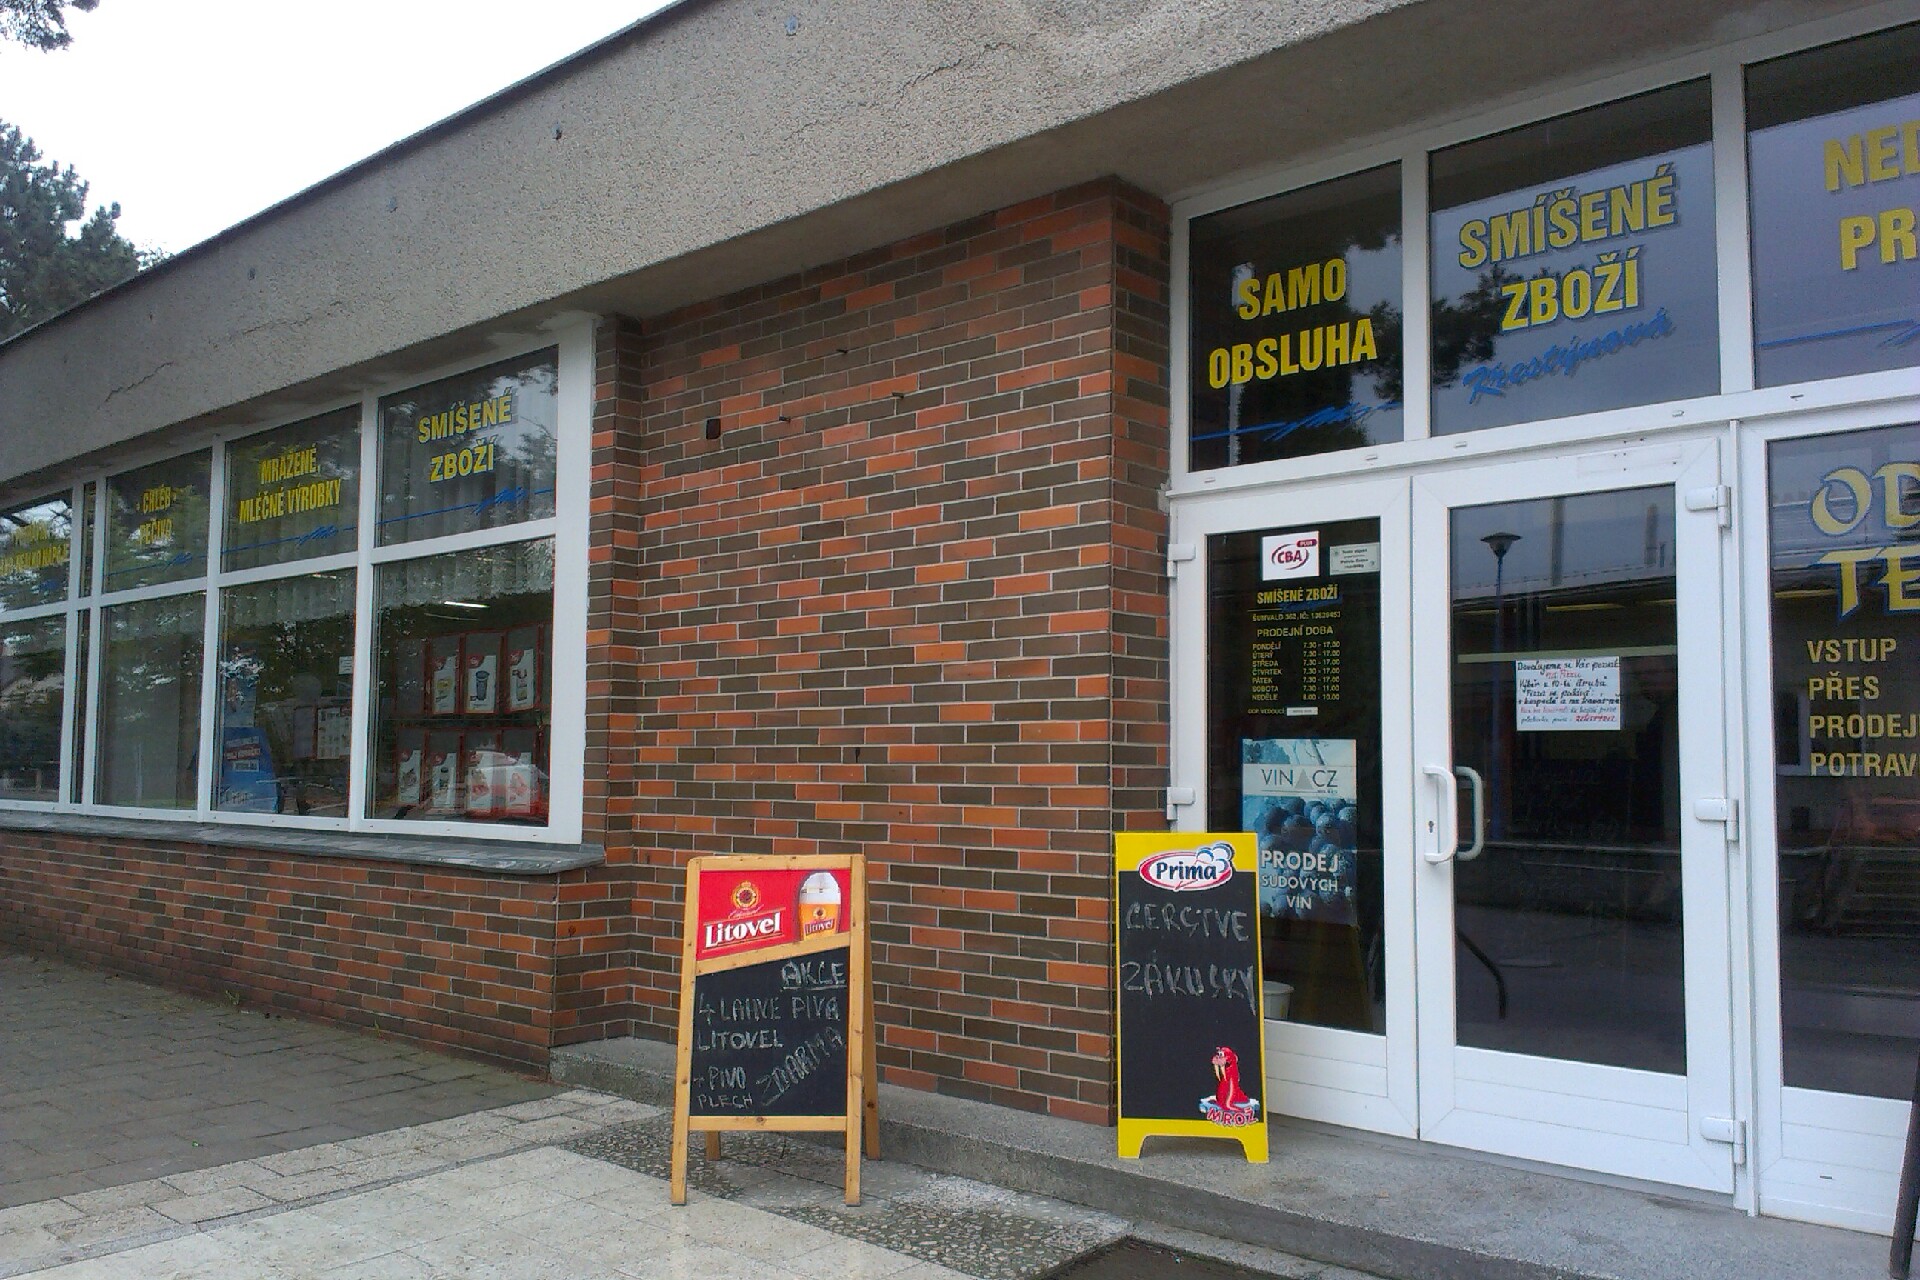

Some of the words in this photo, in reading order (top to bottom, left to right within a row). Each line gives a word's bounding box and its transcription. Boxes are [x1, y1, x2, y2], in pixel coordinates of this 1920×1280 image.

[1458, 162, 1677, 268] SMÍŠENÉ
[1238, 259, 1347, 320] SAMO
[1501, 246, 1643, 331] ZBOŽÍ
[1209, 319, 1378, 389] OBSLUHA
[418, 387, 514, 443] SMÍŠENÉ
[429, 434, 498, 482] ZBOŽÍ
[287, 478, 342, 513] VÝROBKY
[1277, 550, 1302, 564] CBA
[1257, 587, 1304, 604] SMÍŠENÉ
[1306, 584, 1338, 601] ZBOŽÍ
[1257, 624, 1304, 637] PRODEJNÍ
[1305, 626, 1334, 636] DOBA
[1807, 638, 1897, 663] VSTUP
[1252, 667, 1283, 676] ČTVRTEK
[1252, 676, 1273, 684] PÁTEK
[1252, 685, 1279, 693] SOBOTA
[1808, 671, 1880, 700] PŘES
[1809, 713, 1920, 739] PRODEJ
[1810, 752, 1920, 777] POTRAV
[1156, 861, 1217, 880] Prima
[1261, 850, 1339, 873] PRODEJ
[705, 912, 781, 948] Litovel
[805, 919, 834, 935] Litovel
[792, 995, 841, 1021] PIVA
[698, 1030, 784, 1050] LITOVEL
[709, 1066, 746, 1090] PIVO
[697, 1093, 753, 1109] PLECH
